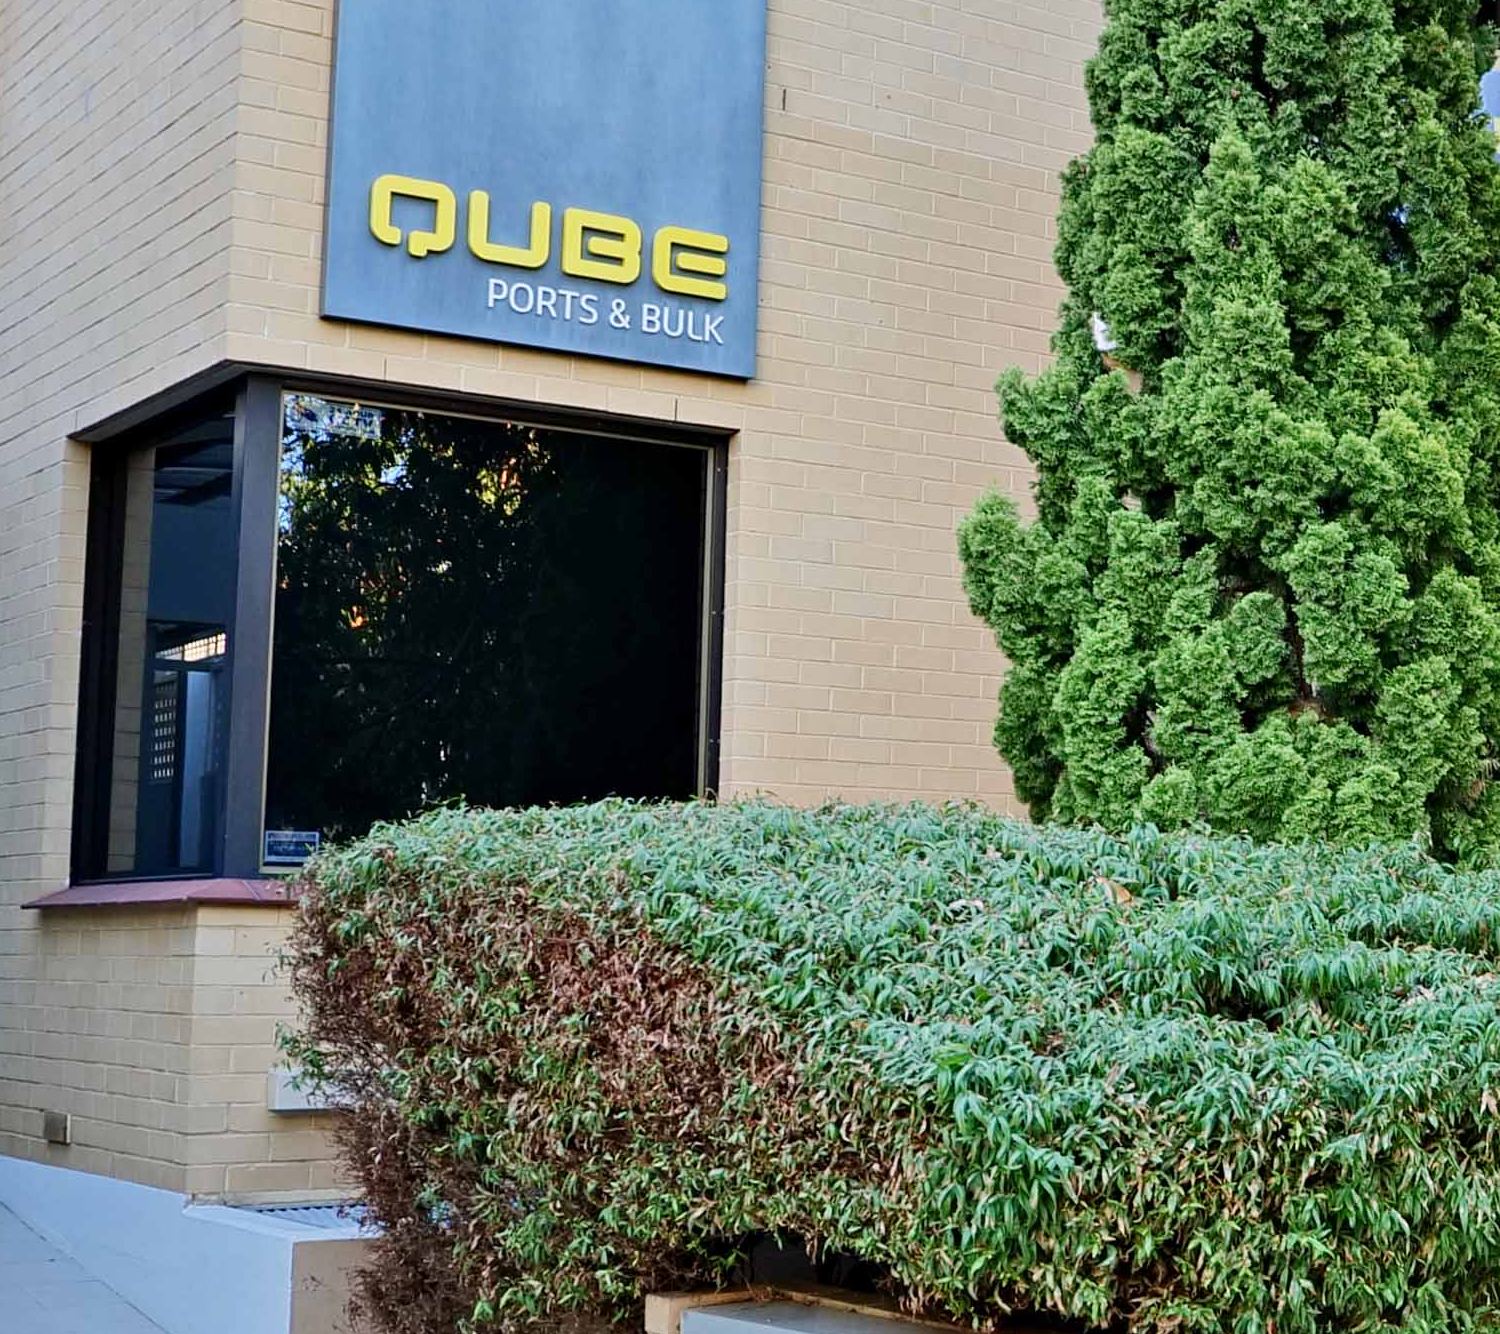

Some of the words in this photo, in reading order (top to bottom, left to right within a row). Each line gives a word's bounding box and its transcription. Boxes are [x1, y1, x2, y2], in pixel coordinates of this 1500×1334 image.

[369, 174, 729, 300] QUBE
[487, 279, 598, 325] PORTS
[609, 299, 631, 329] &
[642, 302, 724, 344] BULK
